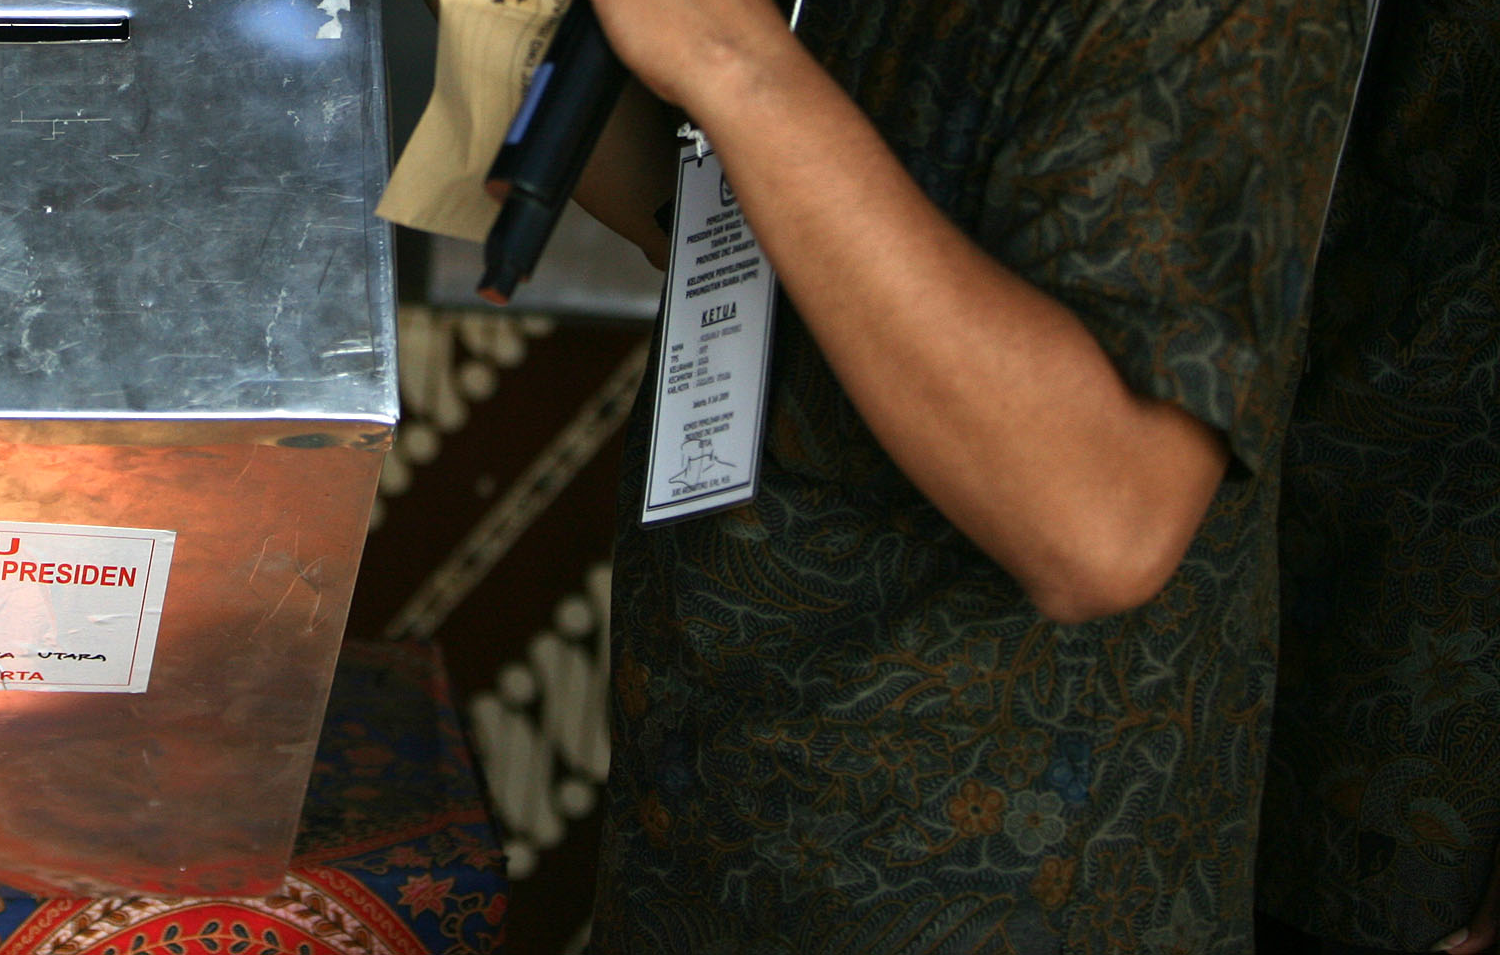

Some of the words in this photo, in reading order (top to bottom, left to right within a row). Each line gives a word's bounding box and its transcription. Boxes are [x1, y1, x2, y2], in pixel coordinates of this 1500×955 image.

[701, 301, 737, 325] KETUA
[1, 560, 137, 587] PRESIDEN
[37, 651, 107, 662] UTARA
